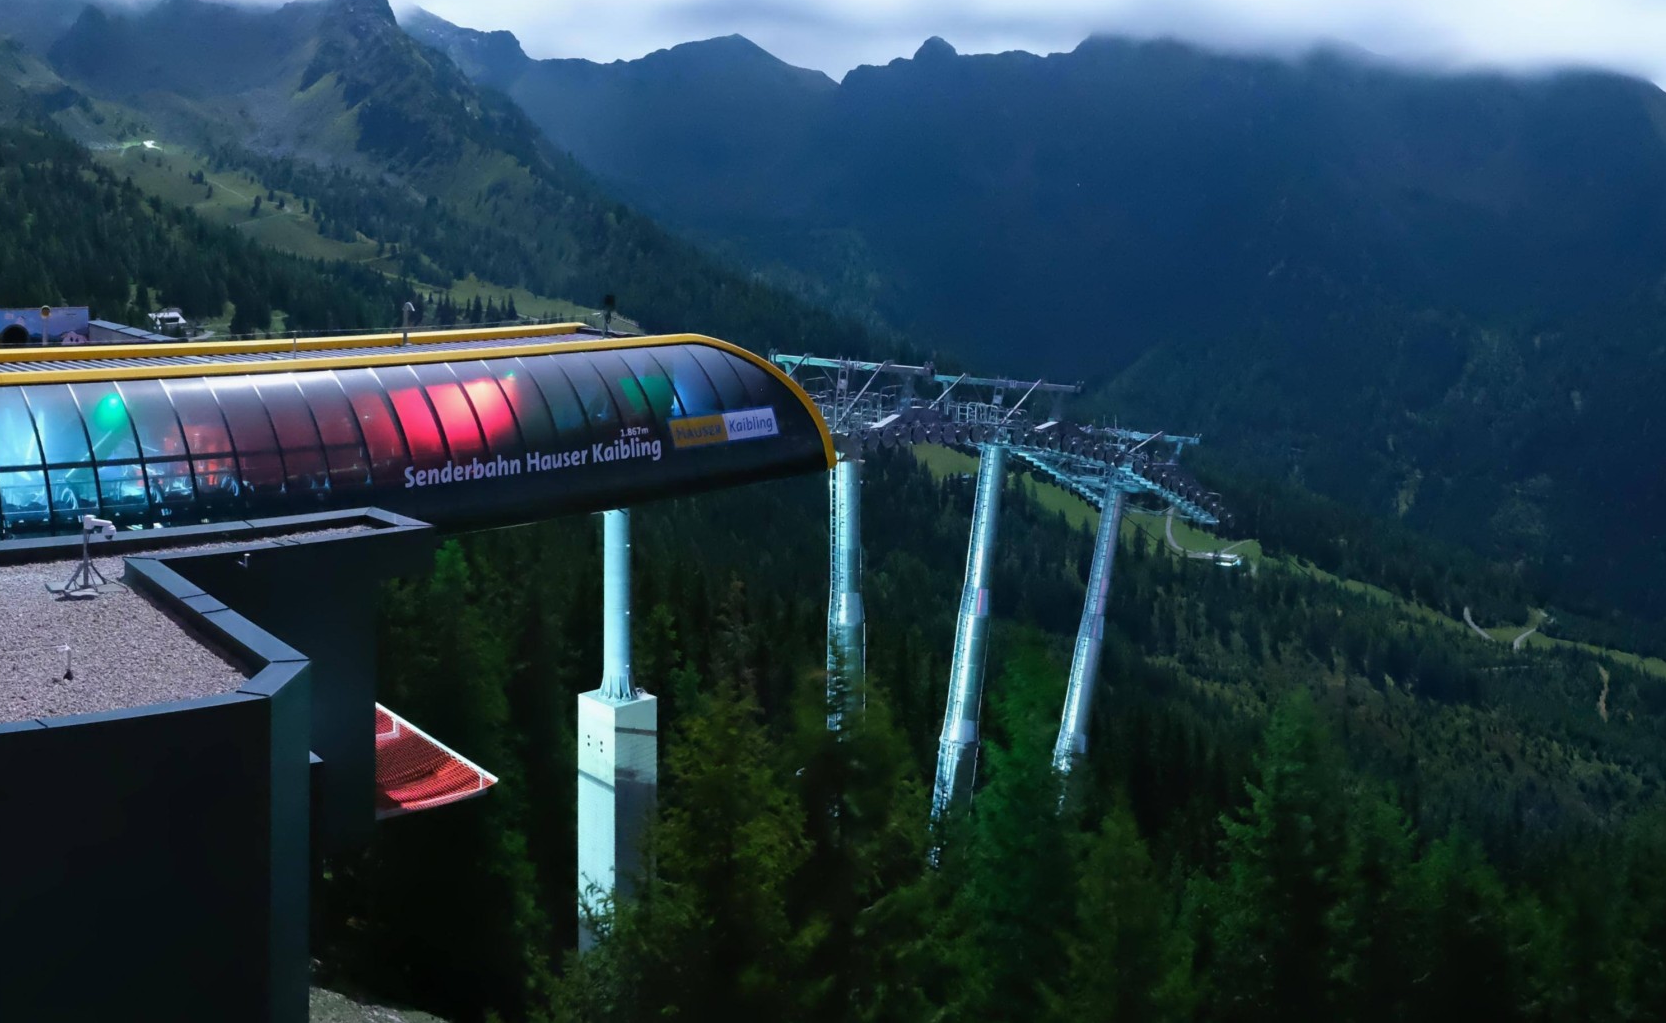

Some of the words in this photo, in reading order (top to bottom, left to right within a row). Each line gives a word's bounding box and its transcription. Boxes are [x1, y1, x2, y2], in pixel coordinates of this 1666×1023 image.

[729, 417, 773, 432] Kaibling
[404, 454, 521, 488] Senderbahn
[526, 448, 588, 472] Hauser
[592, 438, 662, 463] Kaibling
